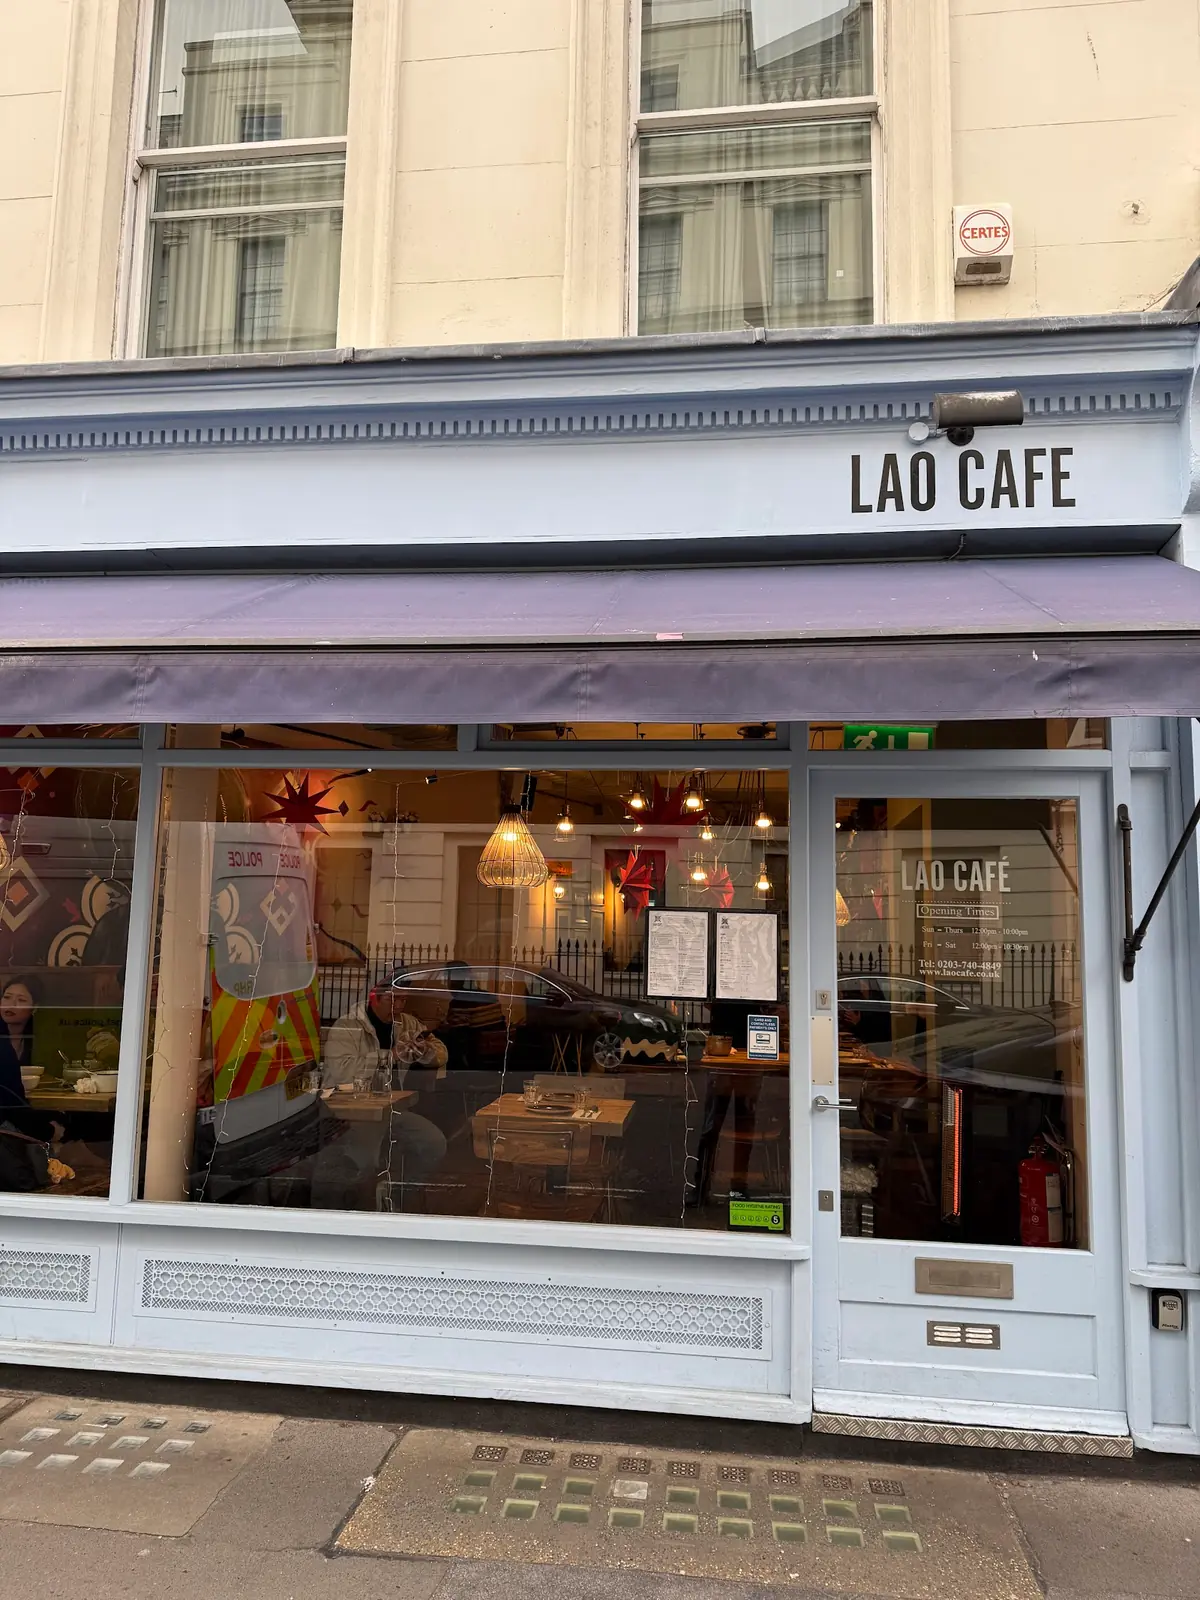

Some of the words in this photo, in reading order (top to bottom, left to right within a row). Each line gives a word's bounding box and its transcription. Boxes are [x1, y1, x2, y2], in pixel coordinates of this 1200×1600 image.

[961, 226, 1009, 239] CERTES
[851, 451, 936, 513] LAO
[958, 447, 1076, 510] CAFE
[901, 860, 945, 891] LAO
[953, 856, 1011, 892] CAFÉ
[920, 906, 963, 917] Opening
[965, 907, 995, 916] Times
[944, 926, 964, 934] Thurs
[971, 927, 997, 936] 12:00pm
[1003, 928, 1029, 936] 10:00pm
[945, 941, 956, 949] Sat
[972, 942, 998, 951] 12:00pm
[1003, 943, 1029, 951] 10:30pm
[918, 959, 935, 968] Tel:
[937, 961, 1002, 970] 0203-740-4849
[919, 968, 1000, 978] www.laocafe.co.uk
